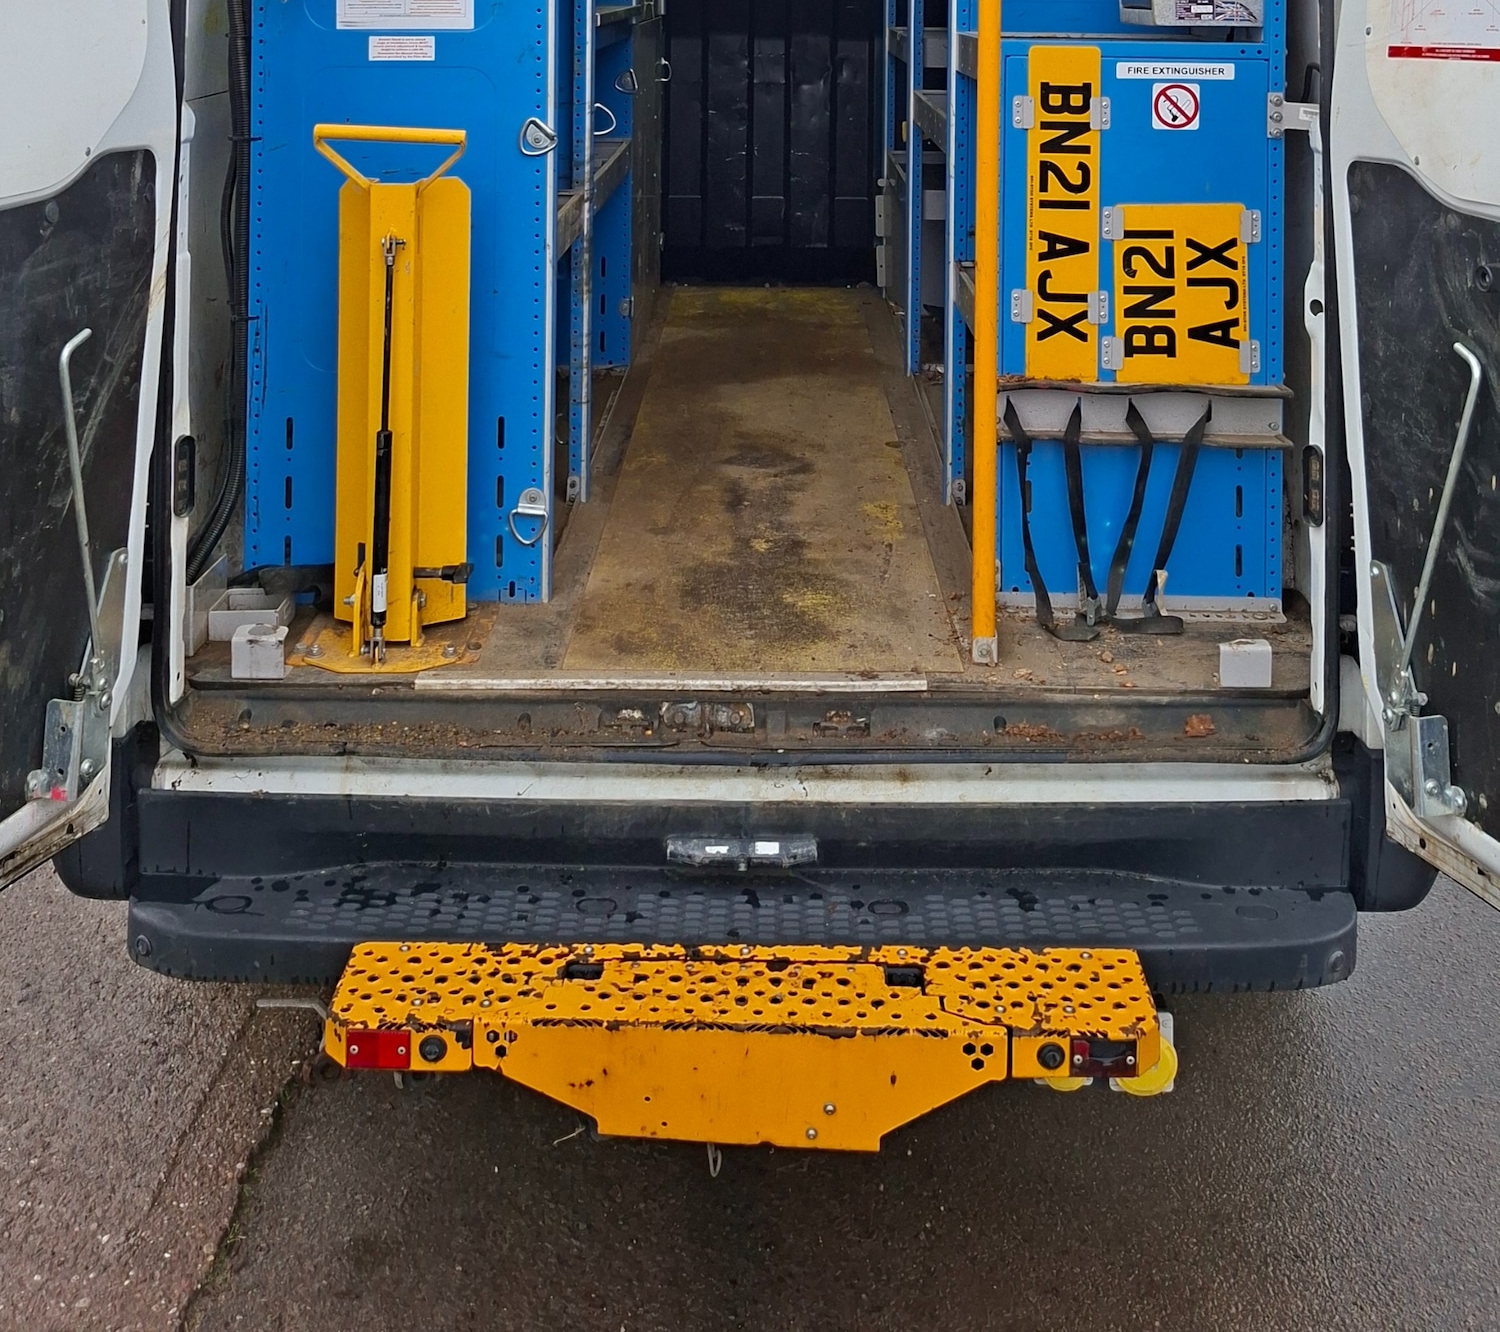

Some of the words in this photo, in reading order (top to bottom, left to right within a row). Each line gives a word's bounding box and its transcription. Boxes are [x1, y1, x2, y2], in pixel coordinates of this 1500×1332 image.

[1128, 66, 1150, 76] FIRE
[1152, 66, 1225, 76] EXTINGUISHER
[1039, 81, 1092, 211] BN21
[1036, 229, 1090, 343] AJX
[1122, 229, 1177, 358] BN21
[1186, 237, 1240, 350] AJX
